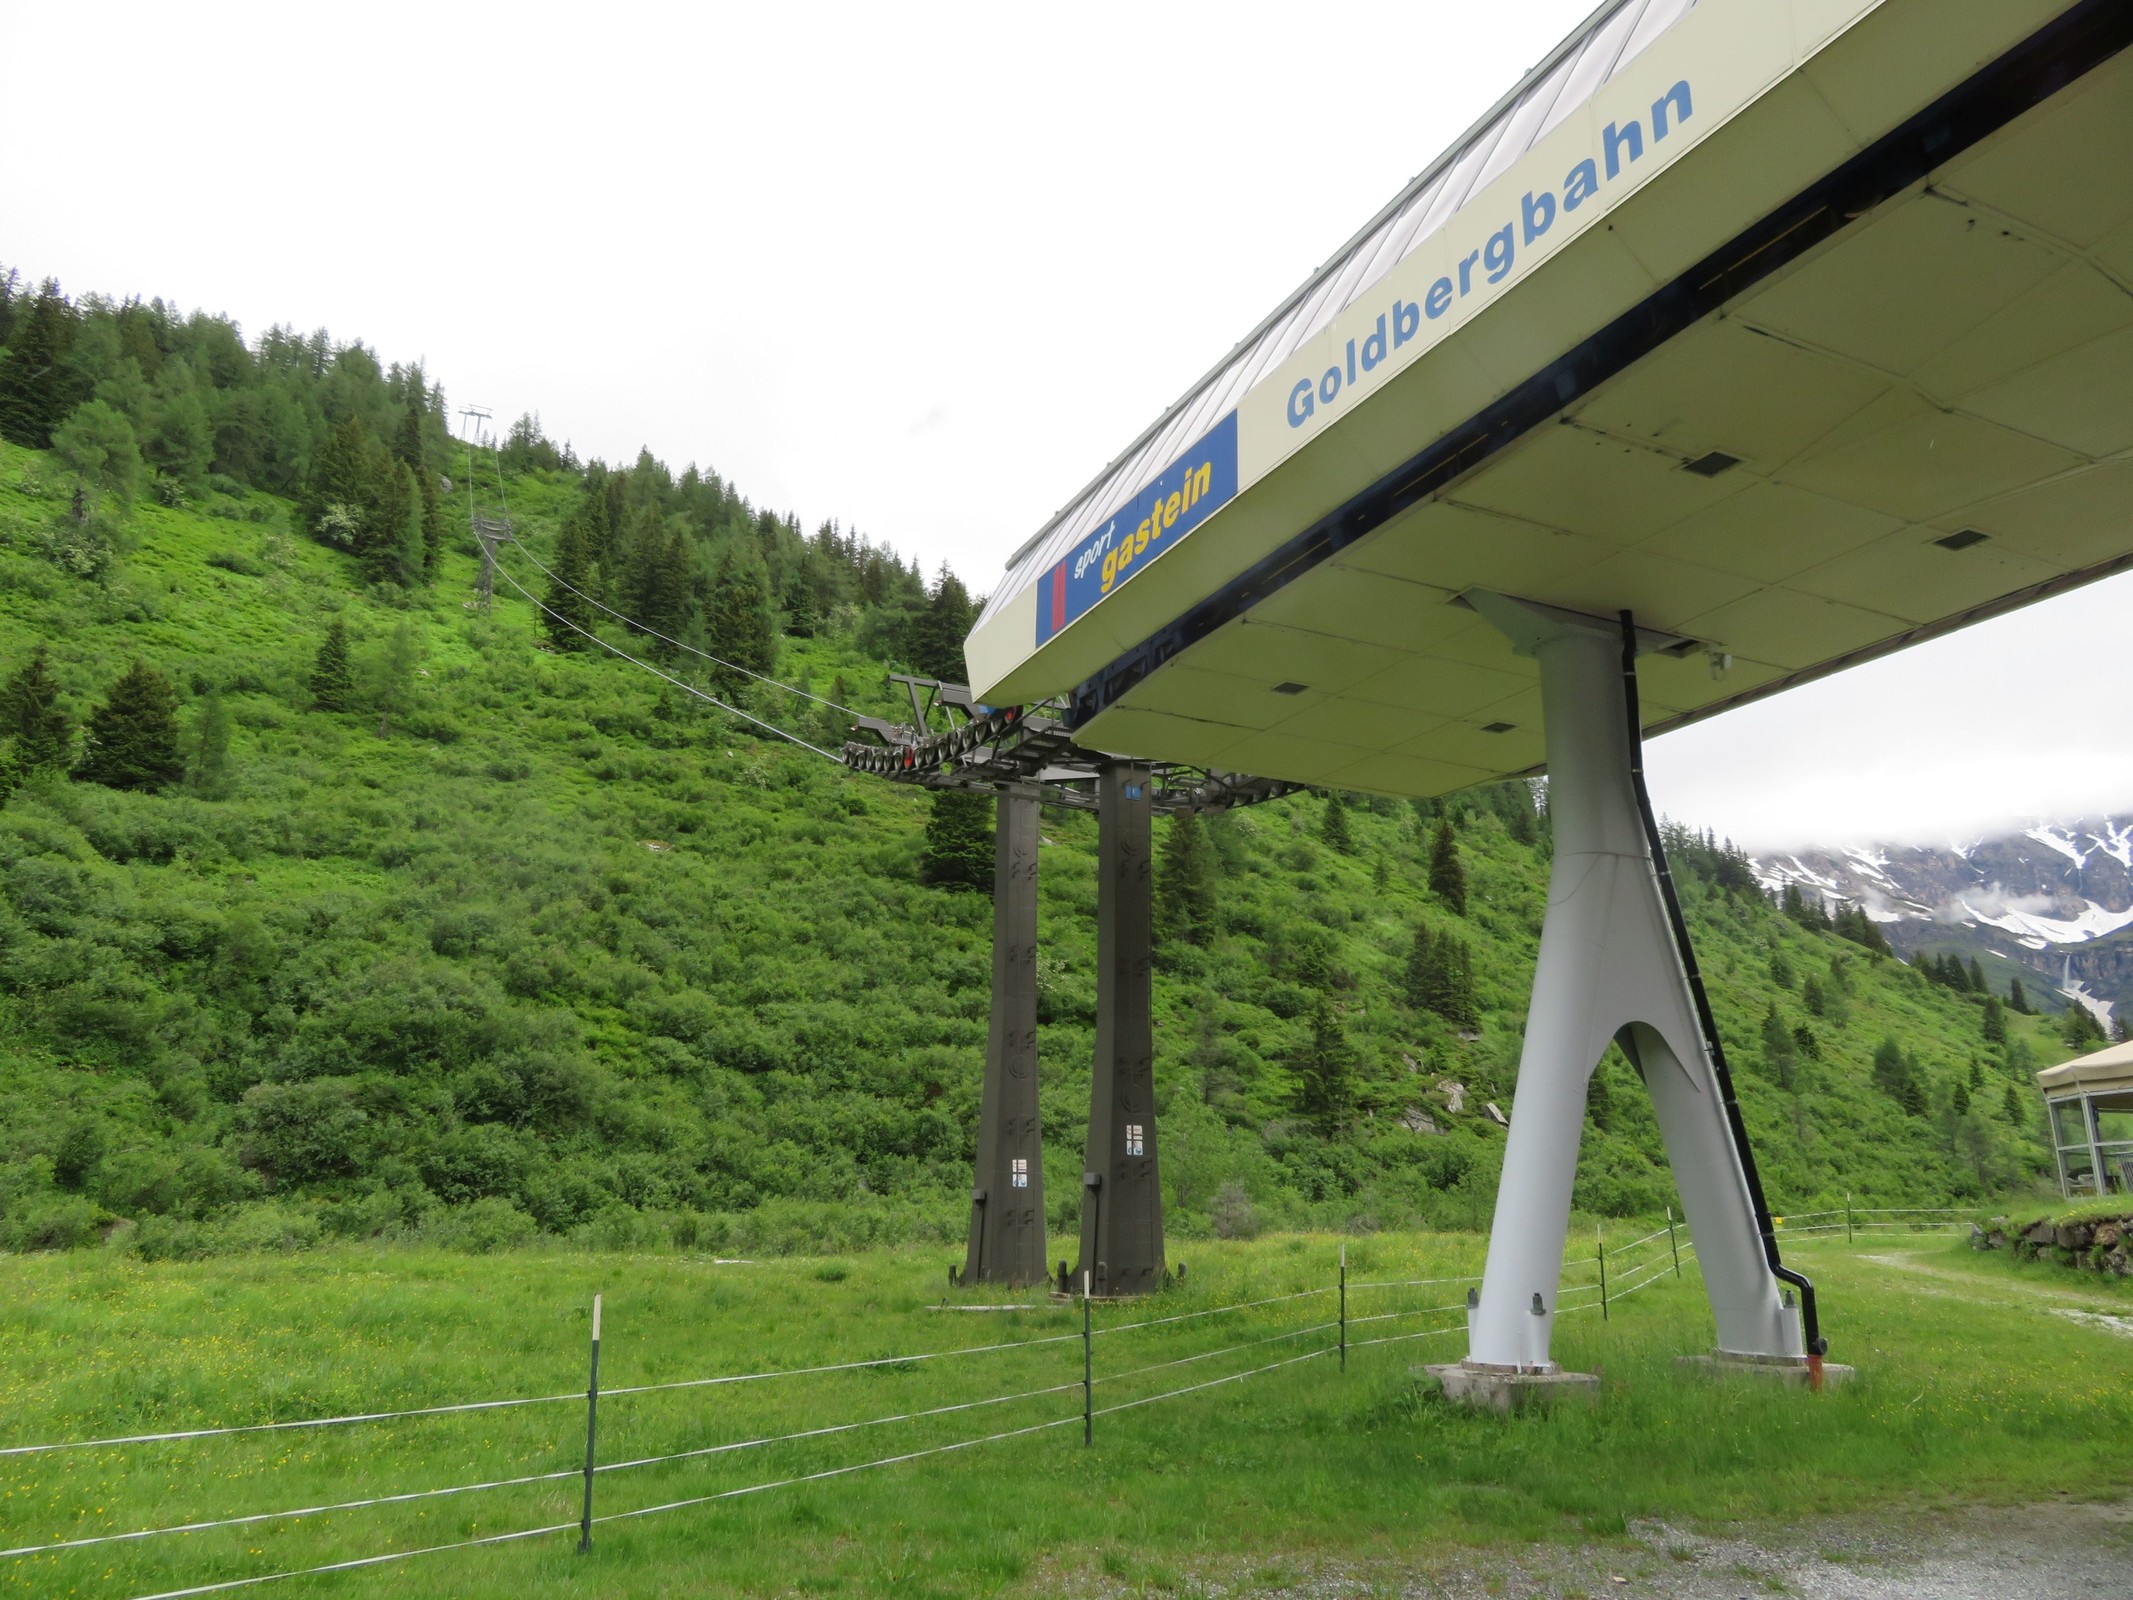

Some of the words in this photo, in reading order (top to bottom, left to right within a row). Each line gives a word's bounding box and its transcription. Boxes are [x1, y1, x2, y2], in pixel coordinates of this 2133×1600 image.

[1287, 79, 1693, 429] Goldbergbahn
[1074, 520, 1115, 579] sport
[1101, 461, 1212, 593] gastein
